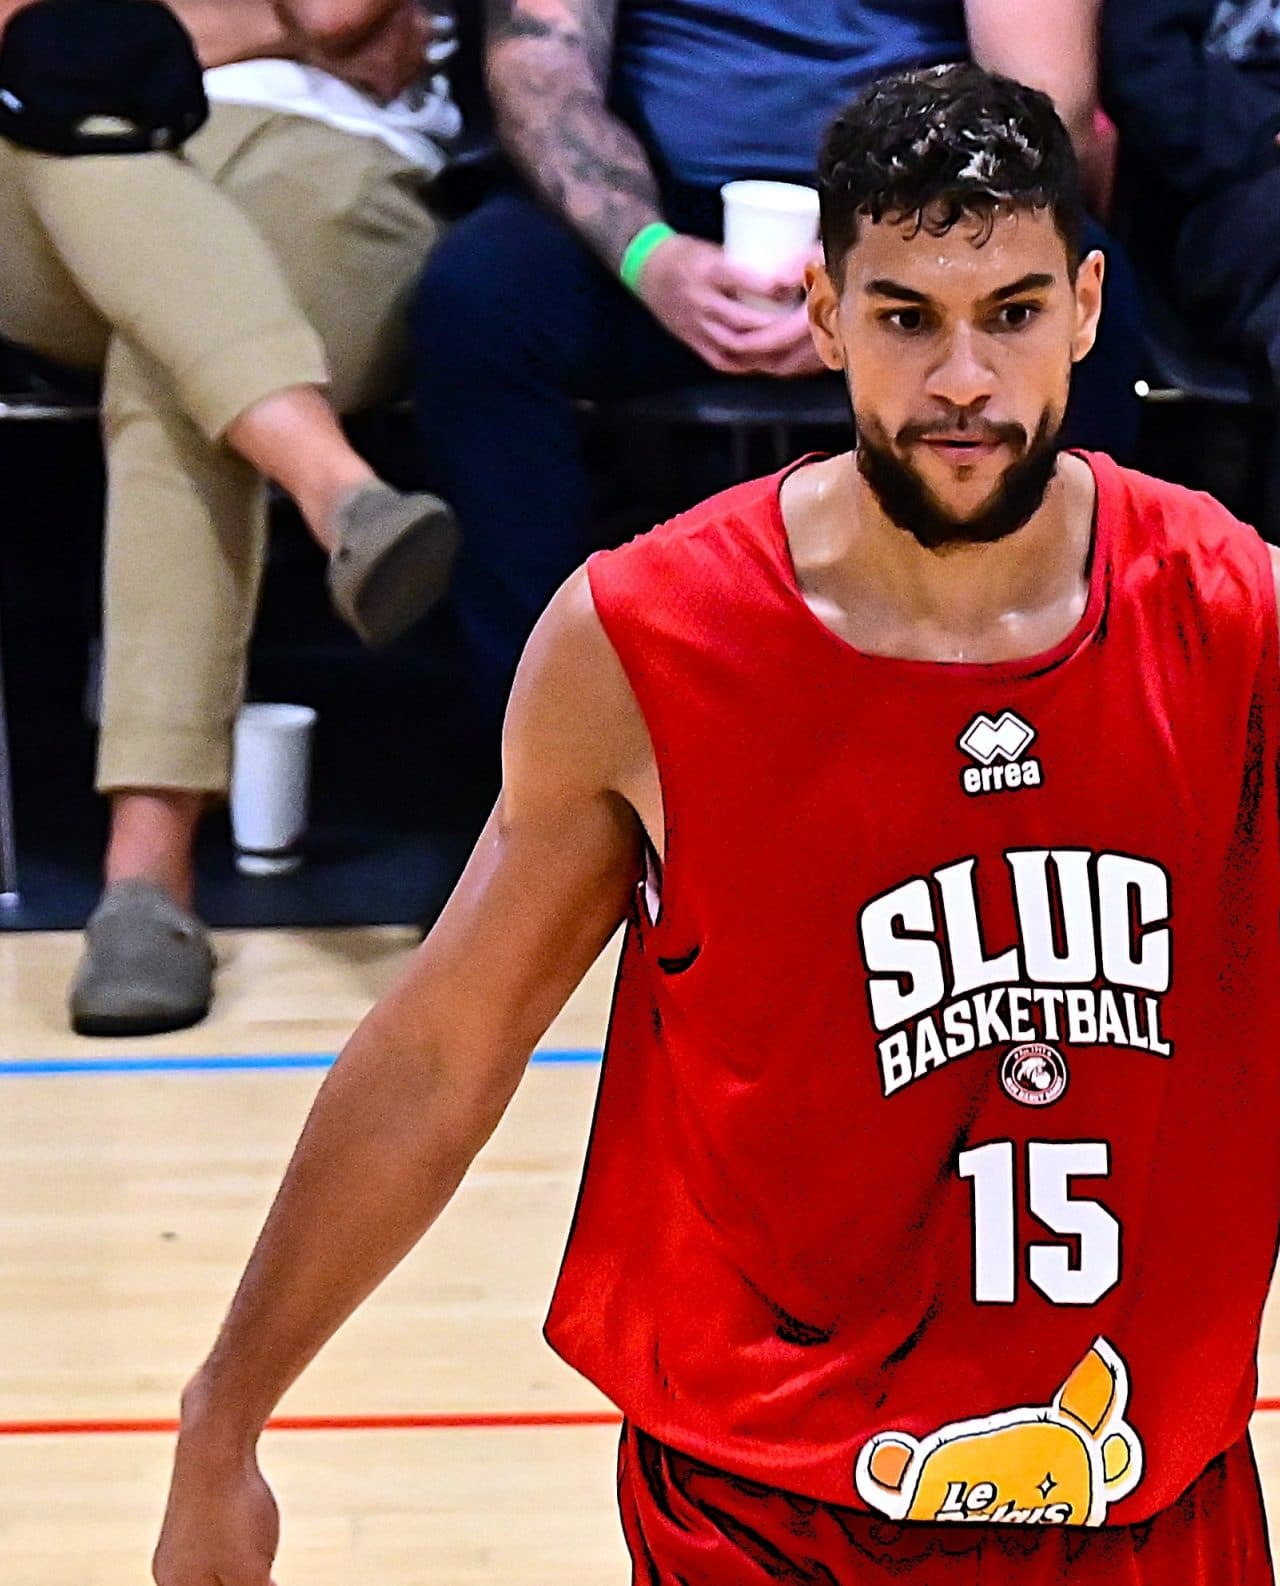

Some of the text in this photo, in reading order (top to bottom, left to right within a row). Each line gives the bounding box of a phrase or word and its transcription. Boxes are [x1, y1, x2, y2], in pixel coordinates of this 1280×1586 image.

[963, 760, 1041, 793] errea
[860, 850, 1170, 1033] SLUC
[878, 987, 1172, 1097] BASKETBALL
[959, 1141, 1119, 1304] 15
[940, 1481, 997, 1513] Le
